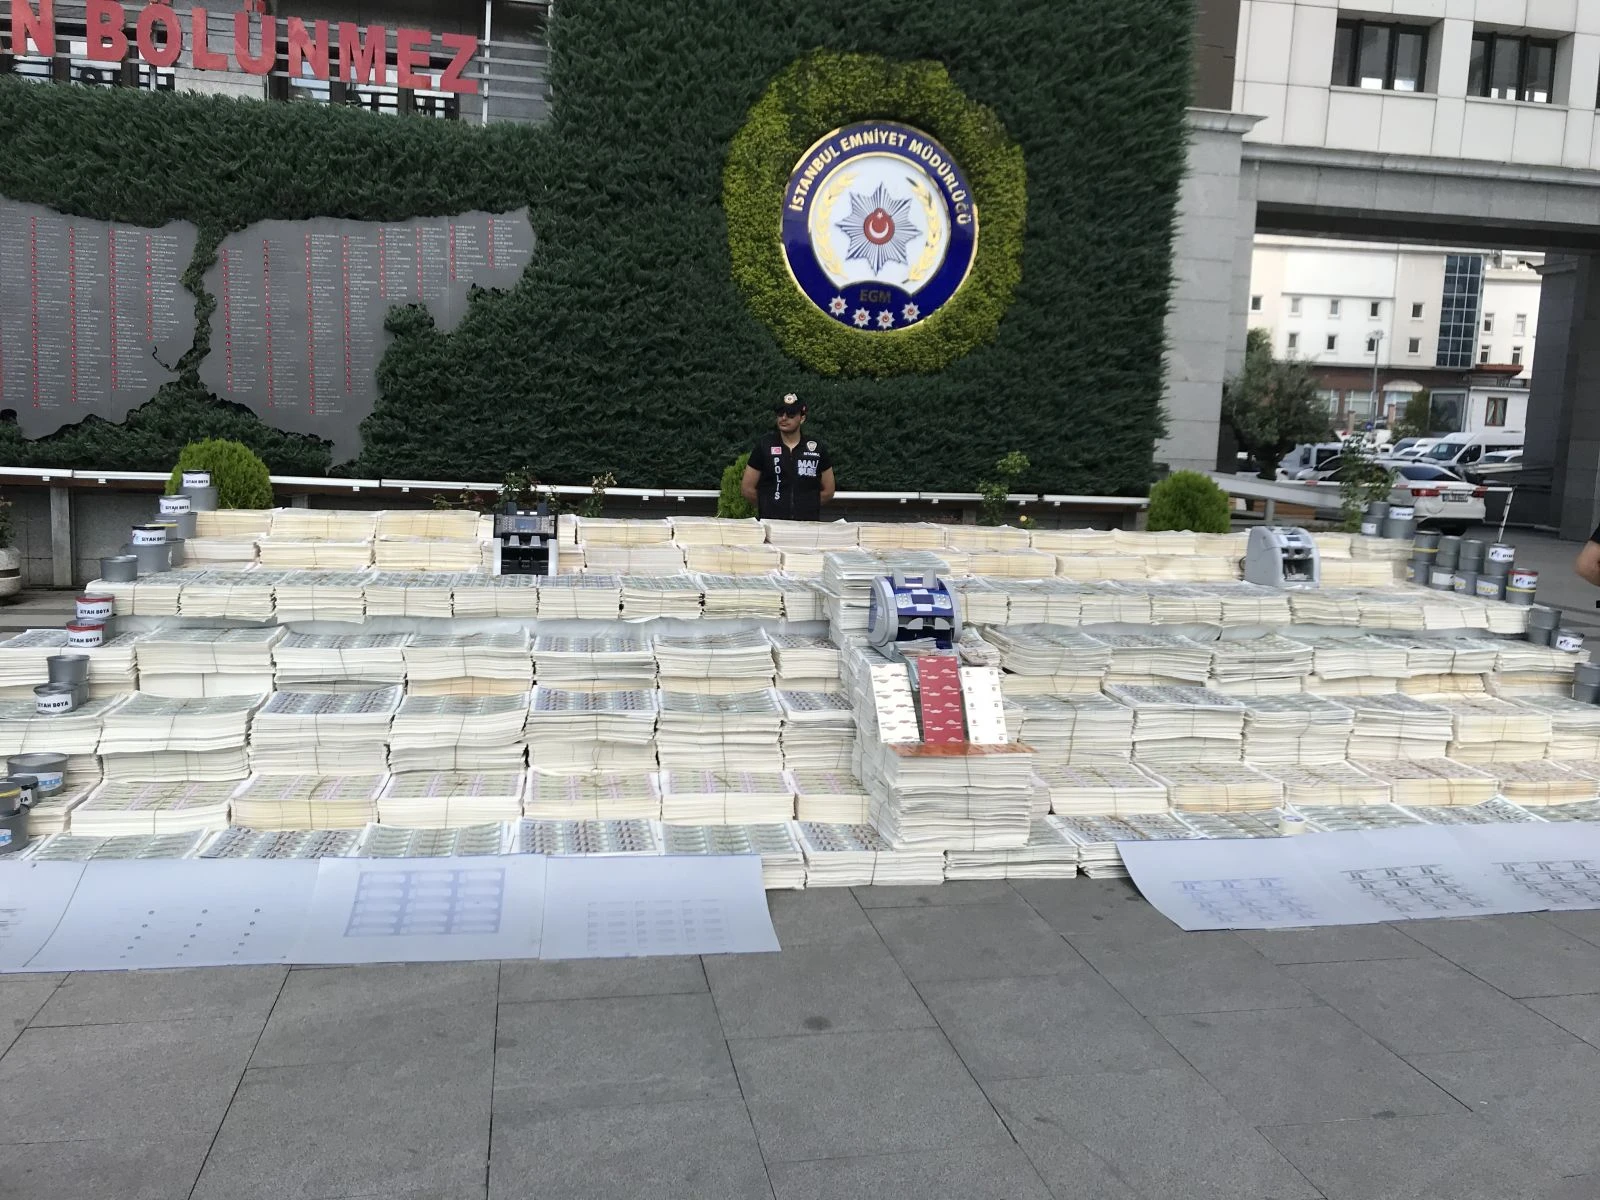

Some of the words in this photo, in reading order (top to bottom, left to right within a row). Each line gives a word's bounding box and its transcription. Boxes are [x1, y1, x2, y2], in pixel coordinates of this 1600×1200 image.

[0, 0, 55, 57] N
[86, 0, 479, 94] BÖLÜNMEZ
[788, 141, 841, 212] İSTANBUL
[840, 127, 908, 152] EMNİYET
[907, 139, 972, 226] MÜDÜRLÜĞÜ
[859, 289, 892, 303] EGM
